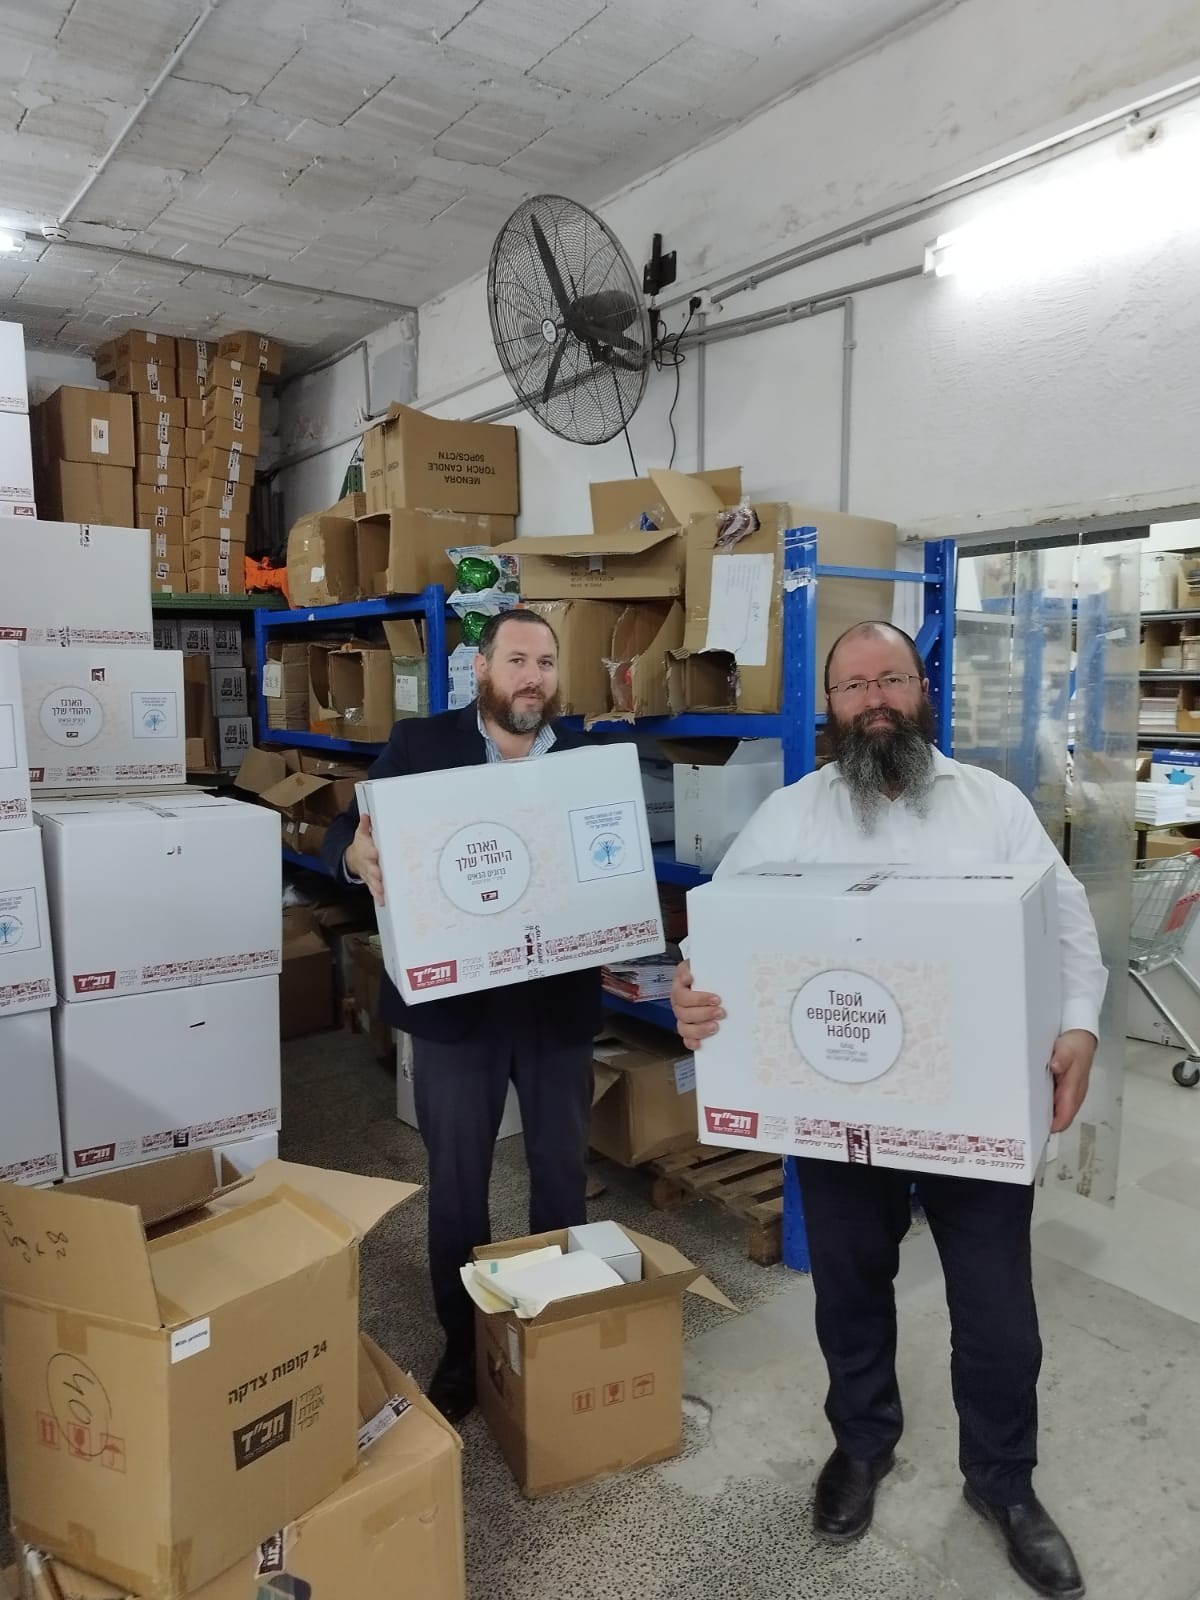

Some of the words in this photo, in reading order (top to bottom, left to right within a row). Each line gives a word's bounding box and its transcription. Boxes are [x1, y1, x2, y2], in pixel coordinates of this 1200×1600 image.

[438, 452, 485, 462] 50PCS/CTN
[427, 463, 462, 472] CANDLE
[466, 465, 496, 475] TORCH
[444, 475, 481, 485] MENORA
[466, 839, 498, 855] הארגז
[455, 857, 477, 873] שלך
[480, 850, 513, 866] היהודי
[828, 989, 863, 1007] Твой
[807, 1006, 887, 1025] еврейский
[827, 1023, 871, 1043] набор
[711, 1112, 752, 1130] חב"ד
[975, 1158, 1025, 1170] 03-3731777
[312, 1340, 328, 1359] 24
[271, 1350, 309, 1382] קופות
[228, 1373, 268, 1405] צדקה
[241, 1413, 286, 1453] חב"ד
